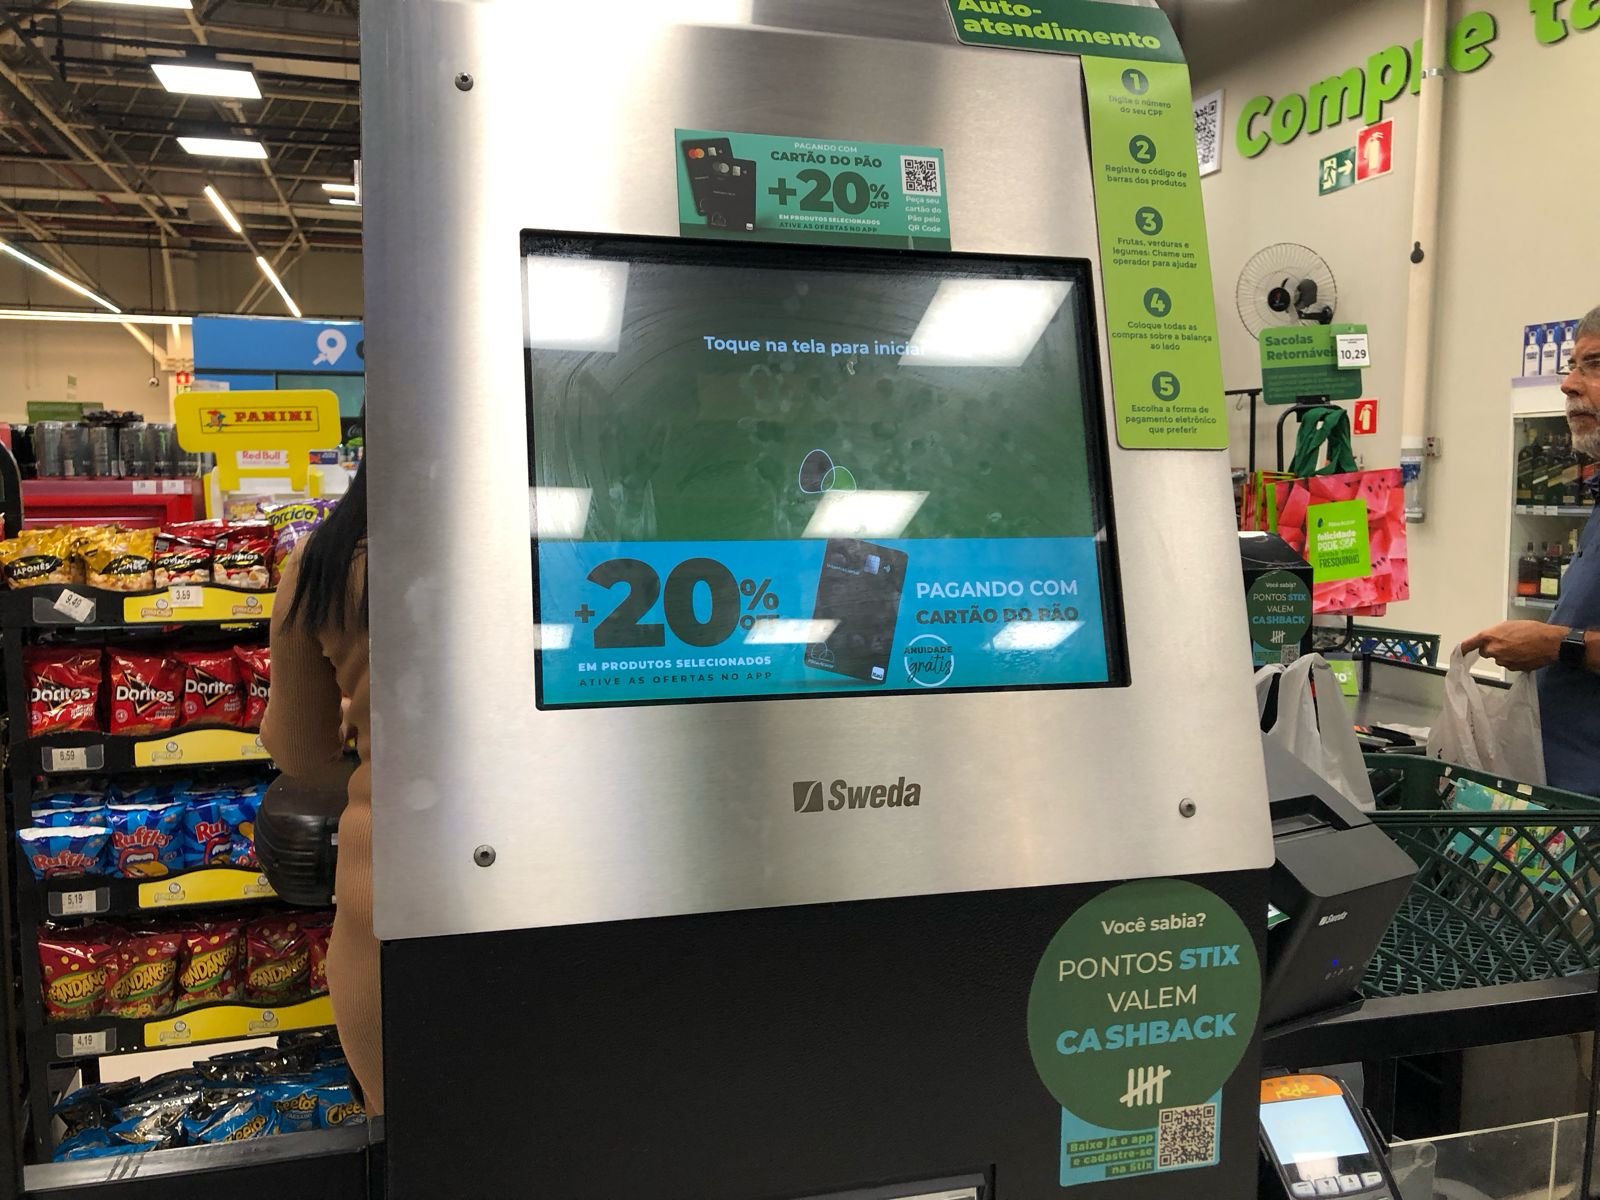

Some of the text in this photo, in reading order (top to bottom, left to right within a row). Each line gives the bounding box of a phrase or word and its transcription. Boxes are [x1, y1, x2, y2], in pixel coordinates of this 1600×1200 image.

[957, 0, 1042, 17] Auto-
[962, 18, 1161, 49] atendimento
[1147, 109, 1164, 117] CPF
[794, 142, 858, 153] PAGANDO COM
[1136, 141, 1151, 159] 2
[770, 151, 882, 168] CARTÃO DO PÃO
[1105, 164, 1139, 175] Registre
[1148, 167, 1175, 178] código
[1177, 170, 1187, 178] de
[1107, 175, 1133, 183] barras
[1151, 178, 1187, 187] produtos
[870, 201, 890, 210] OFF
[790, 214, 828, 222] PRODUTOS
[828, 217, 881, 225] SELECIONADOS
[907, 214, 941, 223] Pão pelo
[1141, 212, 1157, 232] 3
[814, 223, 848, 231] OFERTAS
[908, 224, 941, 233] QR Code
[1117, 237, 1146, 247] Frutas,
[1147, 239, 1183, 248] verduras
[1151, 249, 1180, 258] Chame
[1112, 258, 1197, 269] operador para ajudar
[1150, 293, 1166, 312] 4
[1127, 321, 1161, 331] Coloque
[1163, 322, 1187, 331] todas
[1111, 331, 1148, 340] compras
[1149, 331, 1173, 340] sobre
[1181, 333, 1212, 343] balança
[1265, 334, 1313, 347] Sacolas
[703, 336, 760, 353] Toque
[766, 340, 787, 353] na
[792, 339, 826, 354] tela
[831, 342, 869, 356] para
[1162, 342, 1180, 350] lado
[1340, 349, 1367, 360] 10,29
[1159, 376, 1174, 396] 5
[1131, 404, 1164, 413] Escolha
[1172, 405, 1197, 413] forma
[1198, 405, 1209, 413] de
[234, 410, 313, 423] PANINI
[1125, 415, 1217, 424] pagamento eletrônico
[1148, 426, 1198, 435] que preferir
[242, 450, 281, 460] Red Bull
[13, 561, 51, 576] JAPONÊS
[916, 579, 1078, 599] PAGANDO COM
[1253, 593, 1307, 601] PONTOS STIX
[916, 602, 1079, 624] CARTÃO DO PÃO
[1266, 605, 1294, 613] VALEM
[1252, 616, 1306, 624] CASHBACK
[904, 645, 953, 654] ANUIDADE
[578, 656, 772, 672] EM PRODUTOS SELECIONADOS
[907, 654, 952, 682] grátis
[579, 671, 772, 687] ATIVE AS OFERTAS NO APP
[116, 685, 175, 702] Doritos
[185, 679, 237, 695] Dorito
[31, 687, 90, 702] Doritos
[828, 776, 922, 811] Sweda
[112, 825, 173, 849] Ruffles
[1101, 912, 1207, 935] Você sabia?
[1058, 944, 1240, 982] PONTOS STIX
[1107, 984, 1197, 1013] VALEM
[1056, 1012, 1237, 1055] CASHBACK
[1275, 1083, 1317, 1099] rede
[1070, 1134, 1153, 1152] Baixe já o app
[1073, 1147, 1153, 1166] e cadastre-se
[1111, 1160, 1153, 1174] na Stix
